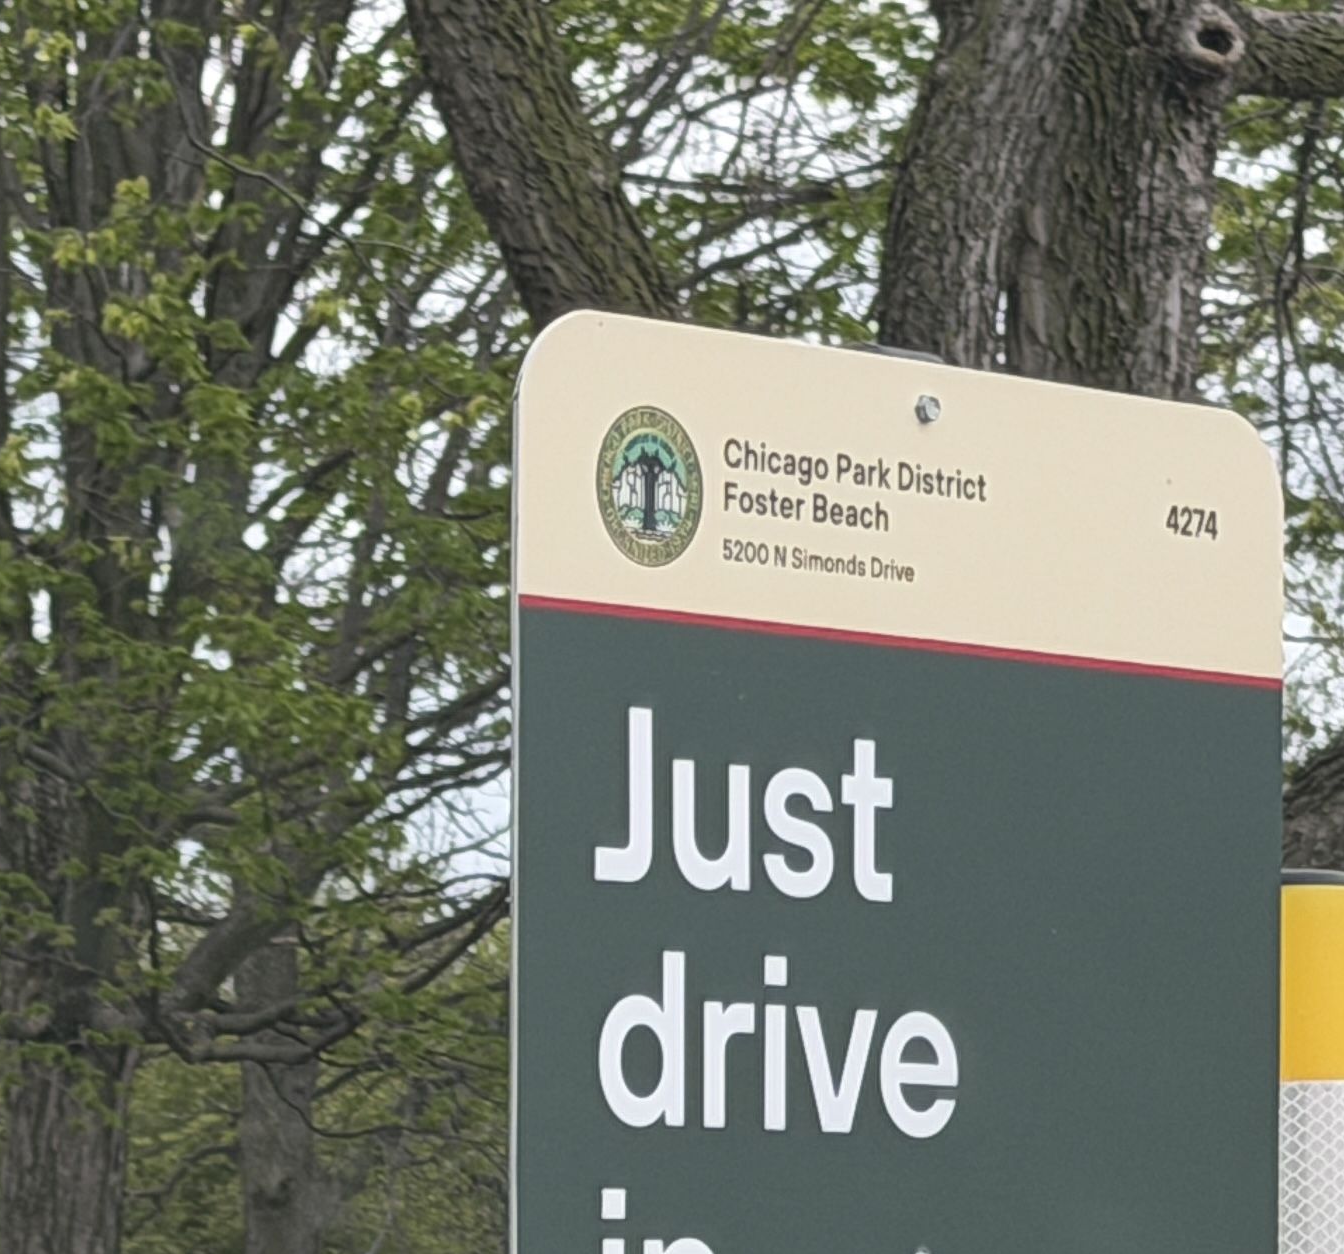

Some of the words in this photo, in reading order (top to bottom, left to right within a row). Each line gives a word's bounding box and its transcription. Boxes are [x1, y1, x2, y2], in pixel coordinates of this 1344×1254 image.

[723, 438, 829, 486] Chicago
[836, 453, 891, 489] Park
[898, 461, 986, 502] District
[724, 482, 806, 521] Foster
[812, 493, 889, 532] Beach
[1166, 505, 1218, 540] 4274
[723, 538, 769, 565] 5200
[773, 544, 788, 568] N
[791, 546, 866, 577] Simonds
[870, 556, 915, 583] Drive
[594, 706, 893, 903] Just
[598, 950, 959, 1139] drive
